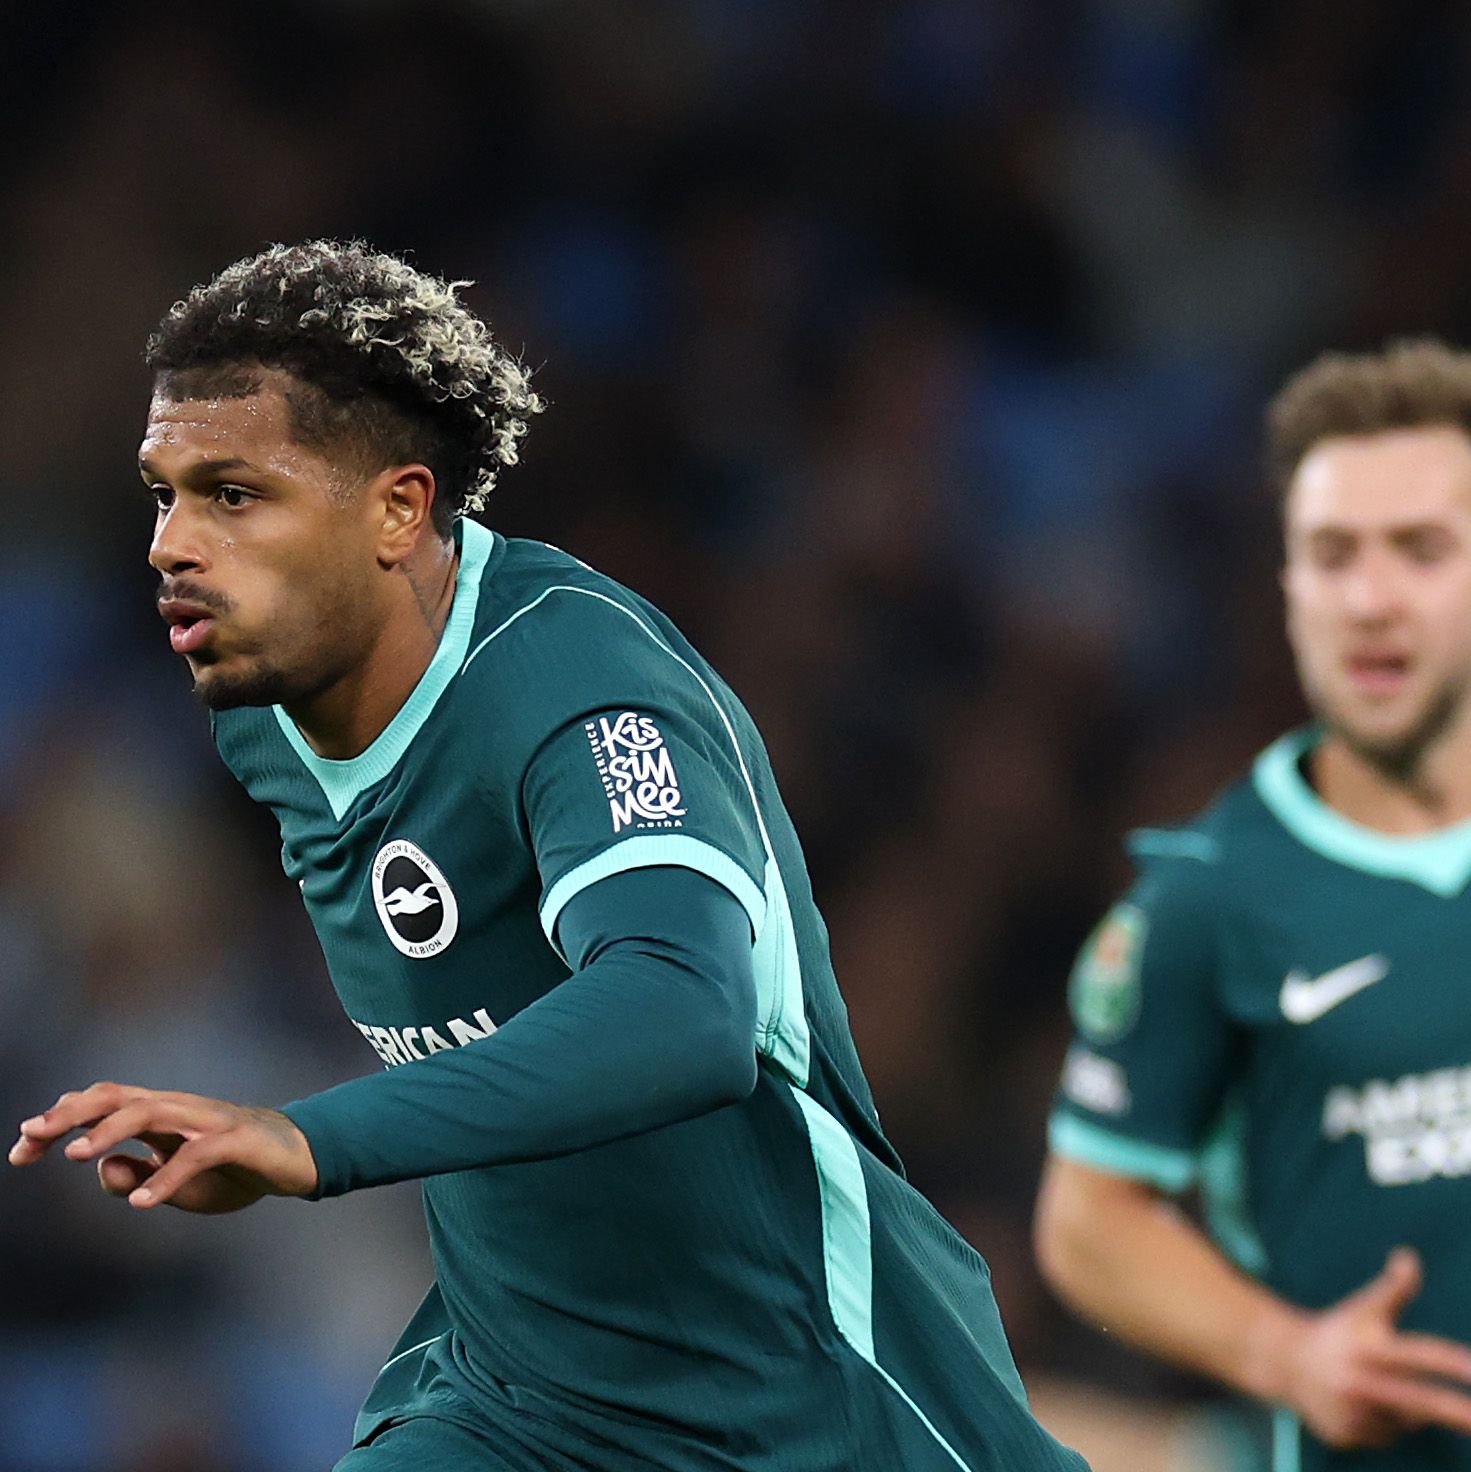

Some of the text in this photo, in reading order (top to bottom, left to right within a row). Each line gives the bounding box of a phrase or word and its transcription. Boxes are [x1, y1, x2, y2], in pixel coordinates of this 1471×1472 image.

[375, 844, 402, 879] BRIGHTON
[410, 848, 433, 872] HOVE
[408, 939, 442, 955] ALBION
[351, 1008, 498, 1066] ERICAN
